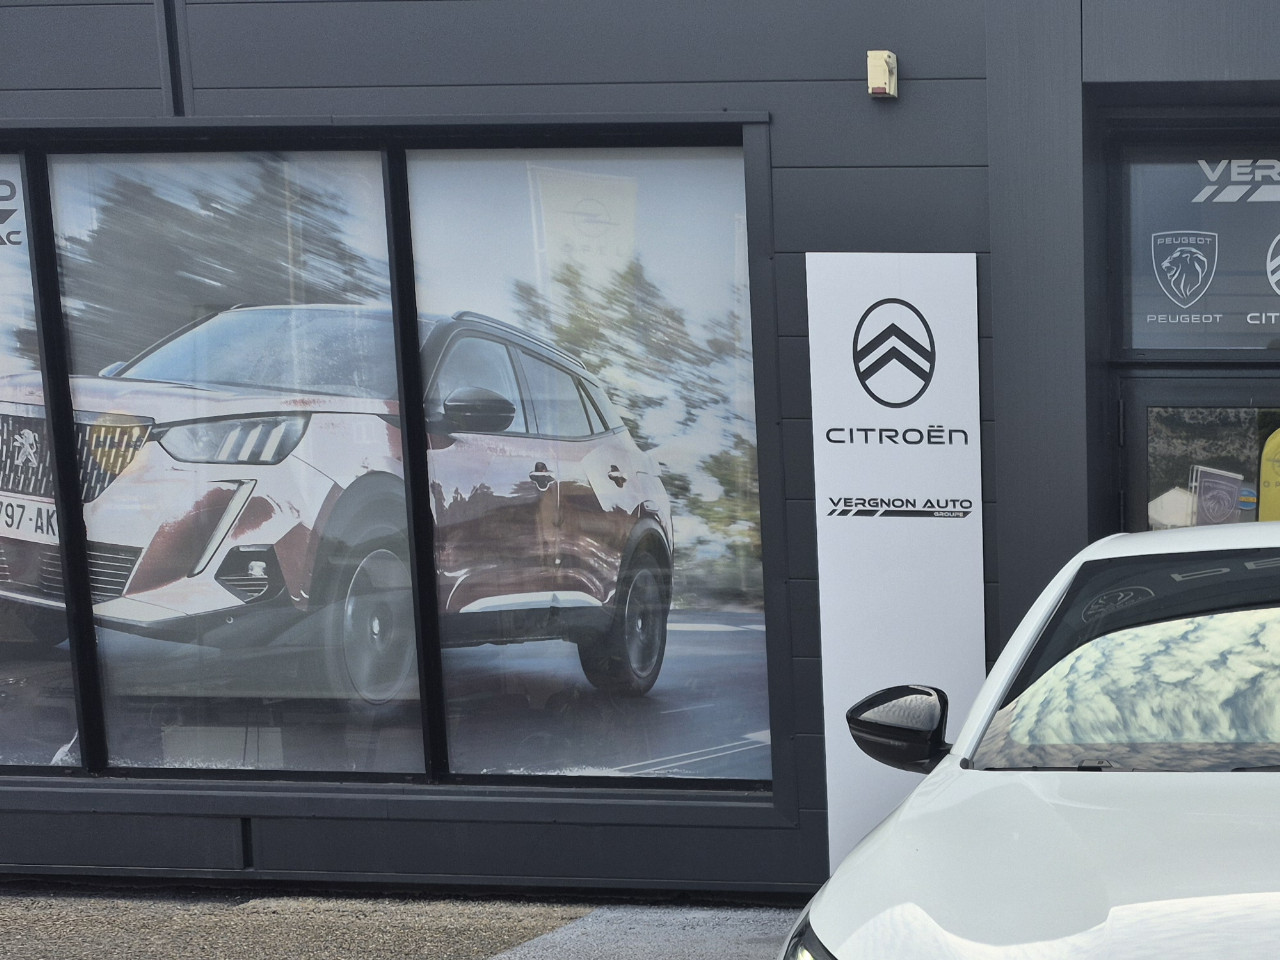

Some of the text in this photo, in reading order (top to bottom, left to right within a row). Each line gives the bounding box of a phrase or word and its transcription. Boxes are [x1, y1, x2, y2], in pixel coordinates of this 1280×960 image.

[1157, 237, 1212, 245] PEUGEOT
[1147, 314, 1223, 323] PEUGEOT
[825, 425, 969, 445] CITROËN
[829, 497, 973, 510] VERGNON AUTO
